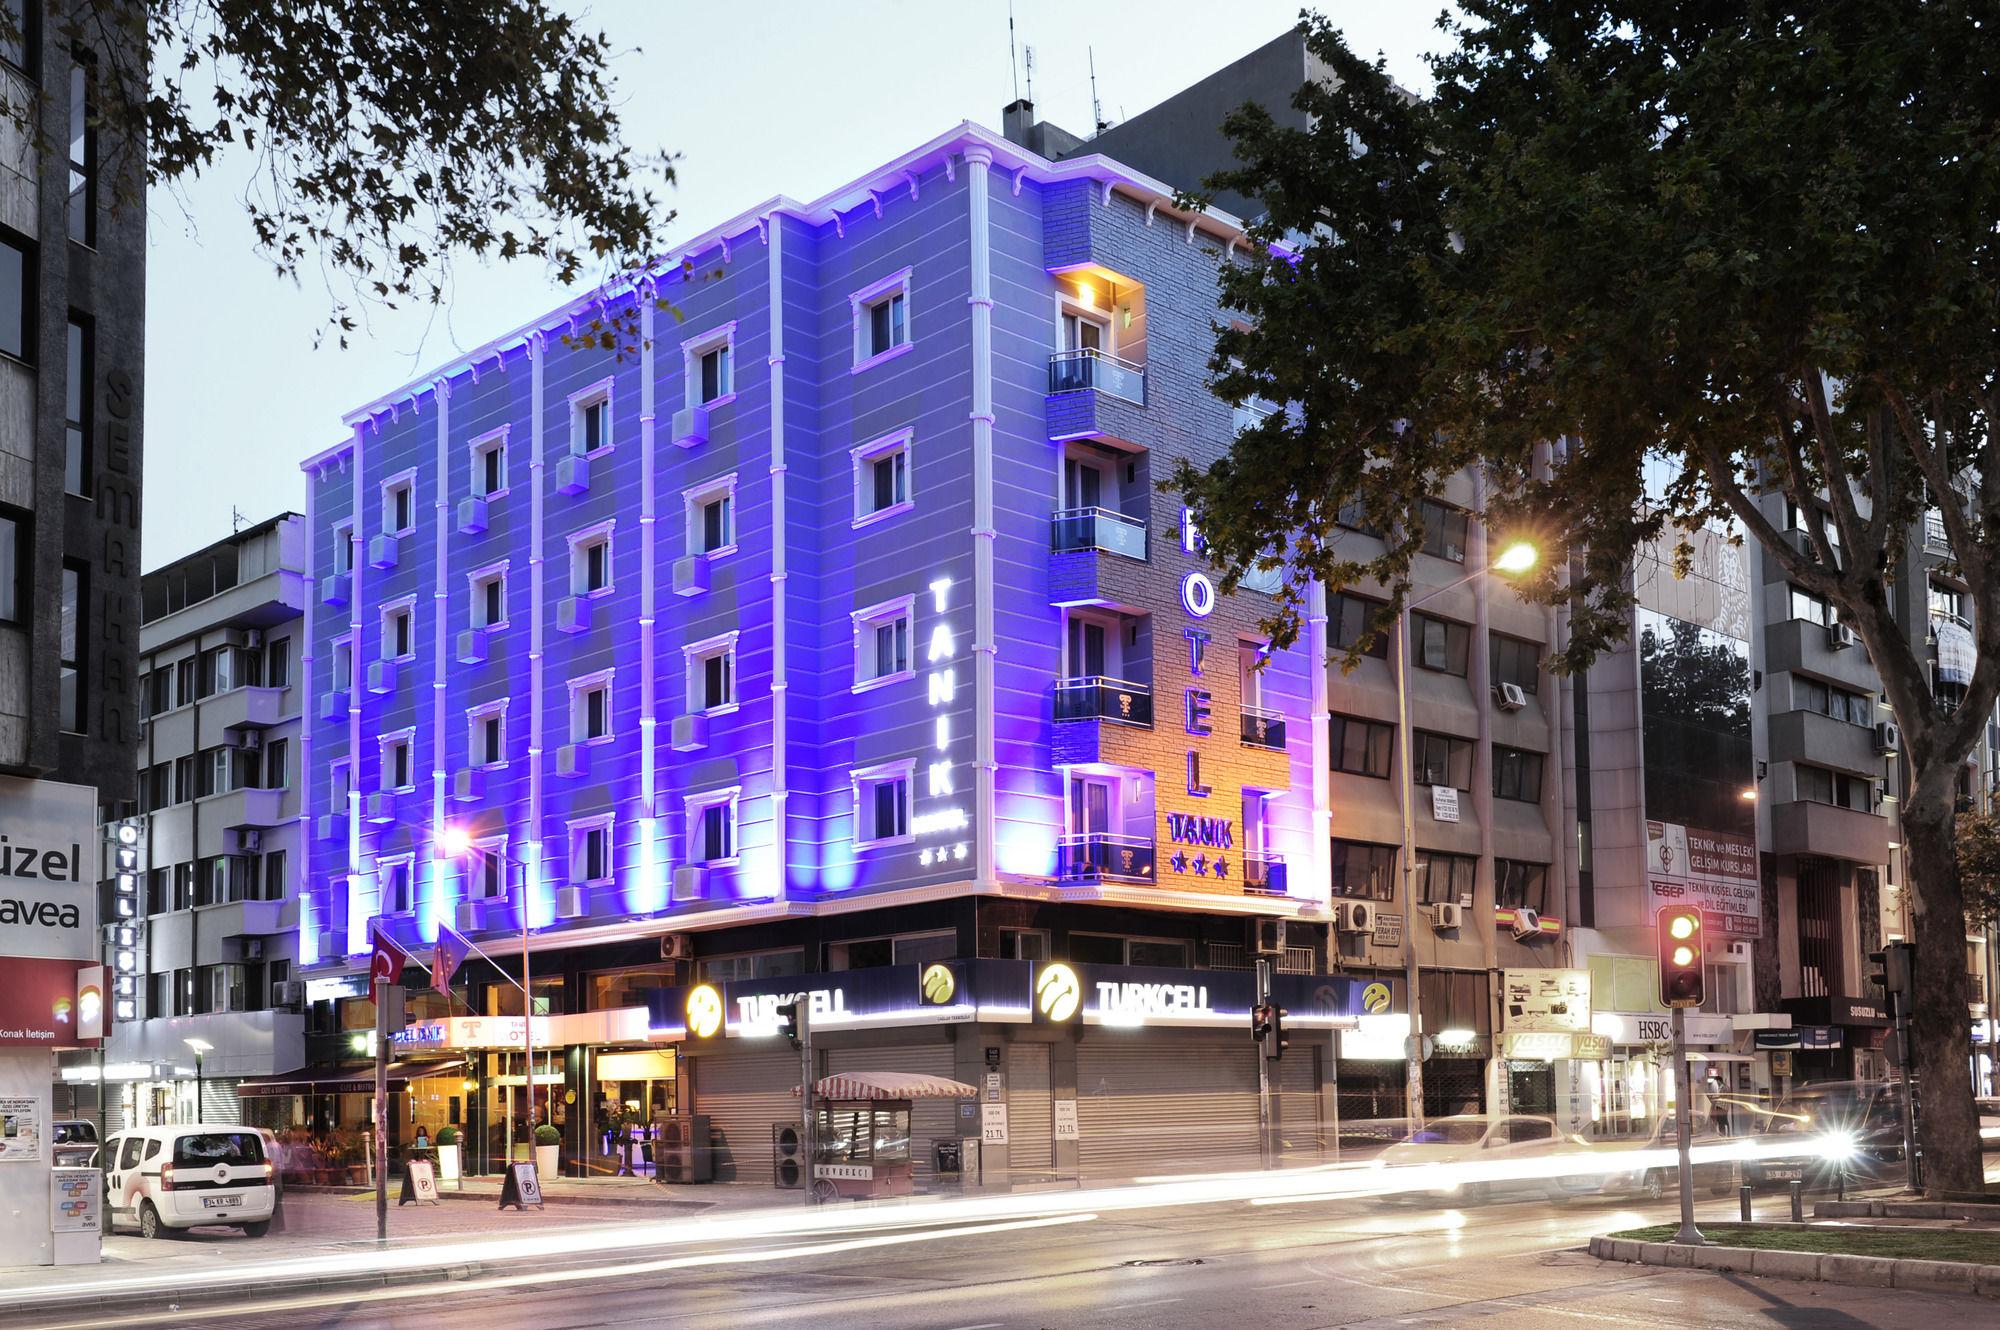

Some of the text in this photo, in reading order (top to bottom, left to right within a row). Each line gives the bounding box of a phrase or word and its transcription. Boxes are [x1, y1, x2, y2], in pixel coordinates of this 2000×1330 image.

[928, 578, 954, 797] TANIK
[1167, 812, 1234, 849] TANIK
[1716, 843, 1725, 854] ve
[119, 825, 137, 916] OTEL
[1096, 981, 1213, 1015] TURKCELL
[26, 1028, 55, 1040] İletişim
[1638, 1020, 1669, 1040] HSBC
[986, 1129, 1004, 1138] 21 TL
